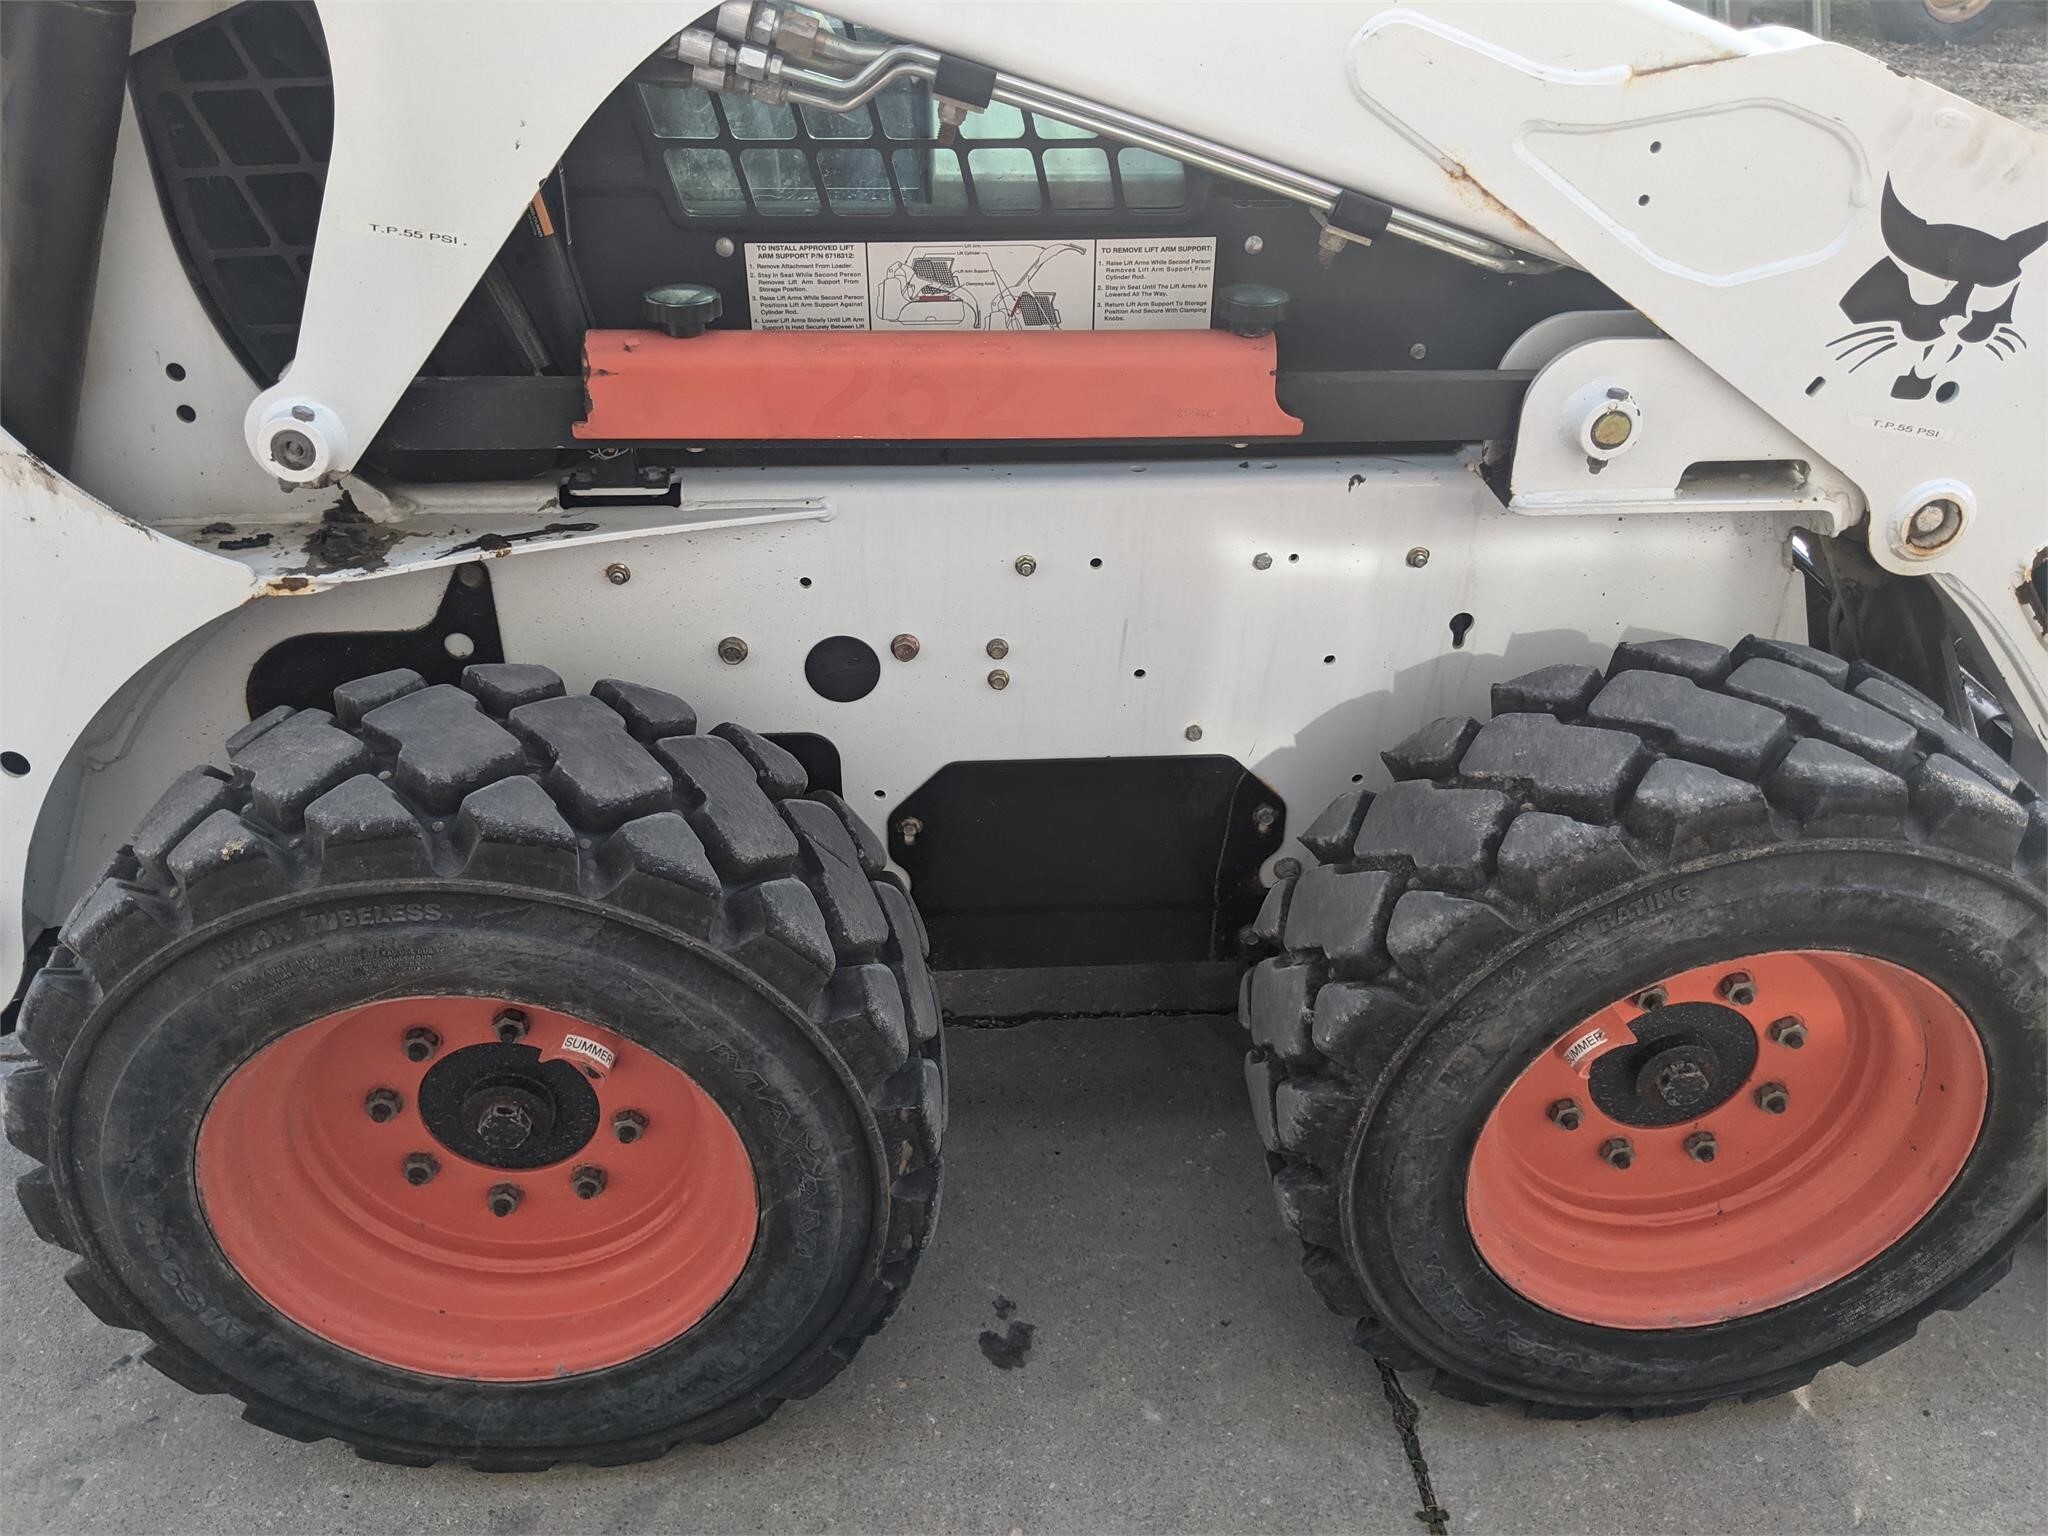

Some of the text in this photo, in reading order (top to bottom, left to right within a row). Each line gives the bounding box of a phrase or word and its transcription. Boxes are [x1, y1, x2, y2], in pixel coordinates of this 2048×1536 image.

[368, 223, 424, 239] T.P.55
[1872, 419, 1940, 438] T.P.55 PSI
[302, 903, 442, 933] TUBELESS
[1594, 883, 1692, 934] RATING
[564, 1036, 613, 1065] SUMMER
